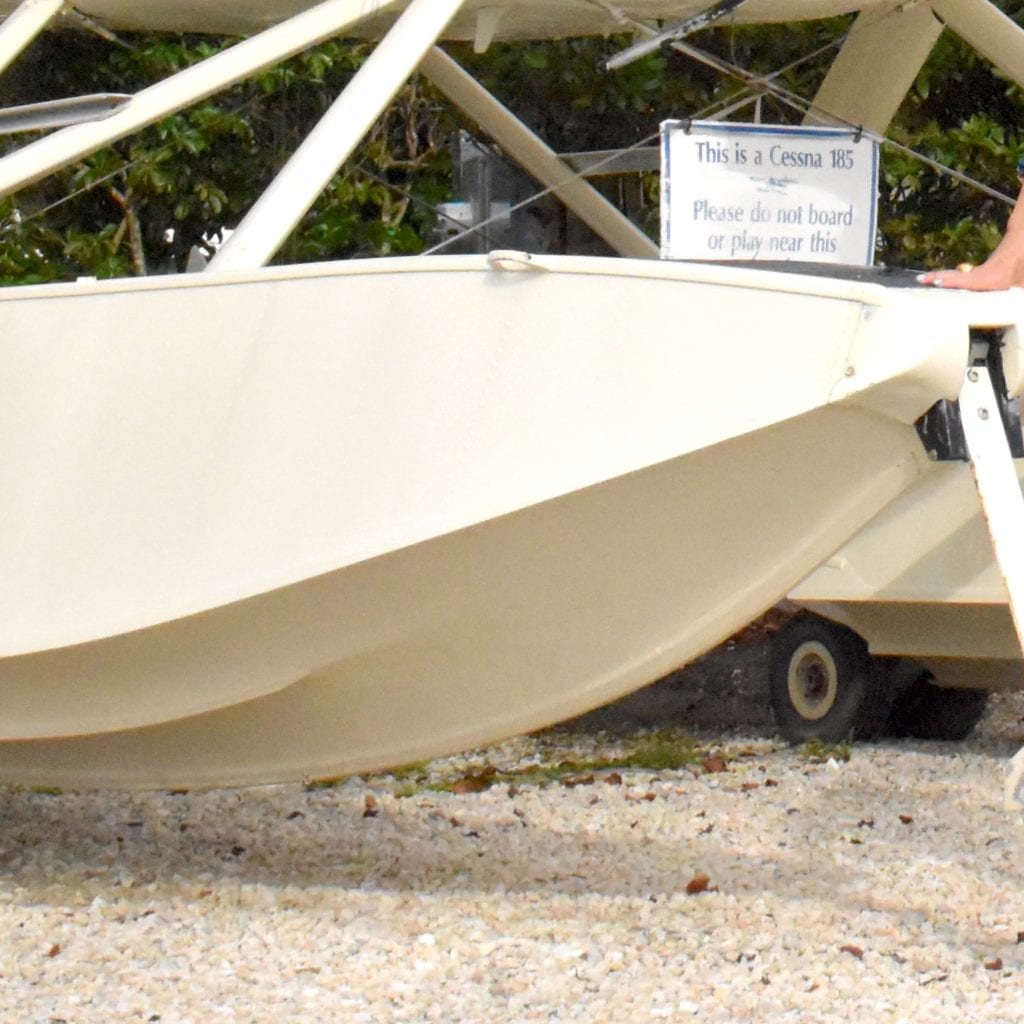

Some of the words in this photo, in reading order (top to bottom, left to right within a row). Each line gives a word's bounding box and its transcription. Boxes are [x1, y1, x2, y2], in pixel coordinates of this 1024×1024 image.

[695, 142, 729, 164] This
[735, 142, 748, 165] is
[753, 149, 763, 166] a
[769, 144, 823, 169] Cessna
[829, 148, 854, 170] 185
[693, 199, 744, 222] Please
[750, 201, 771, 223] do
[777, 205, 803, 225] not
[808, 204, 853, 226] board
[707, 232, 724, 250] or
[730, 229, 764, 260] play
[769, 232, 804, 253] near
[810, 230, 837, 254] this
